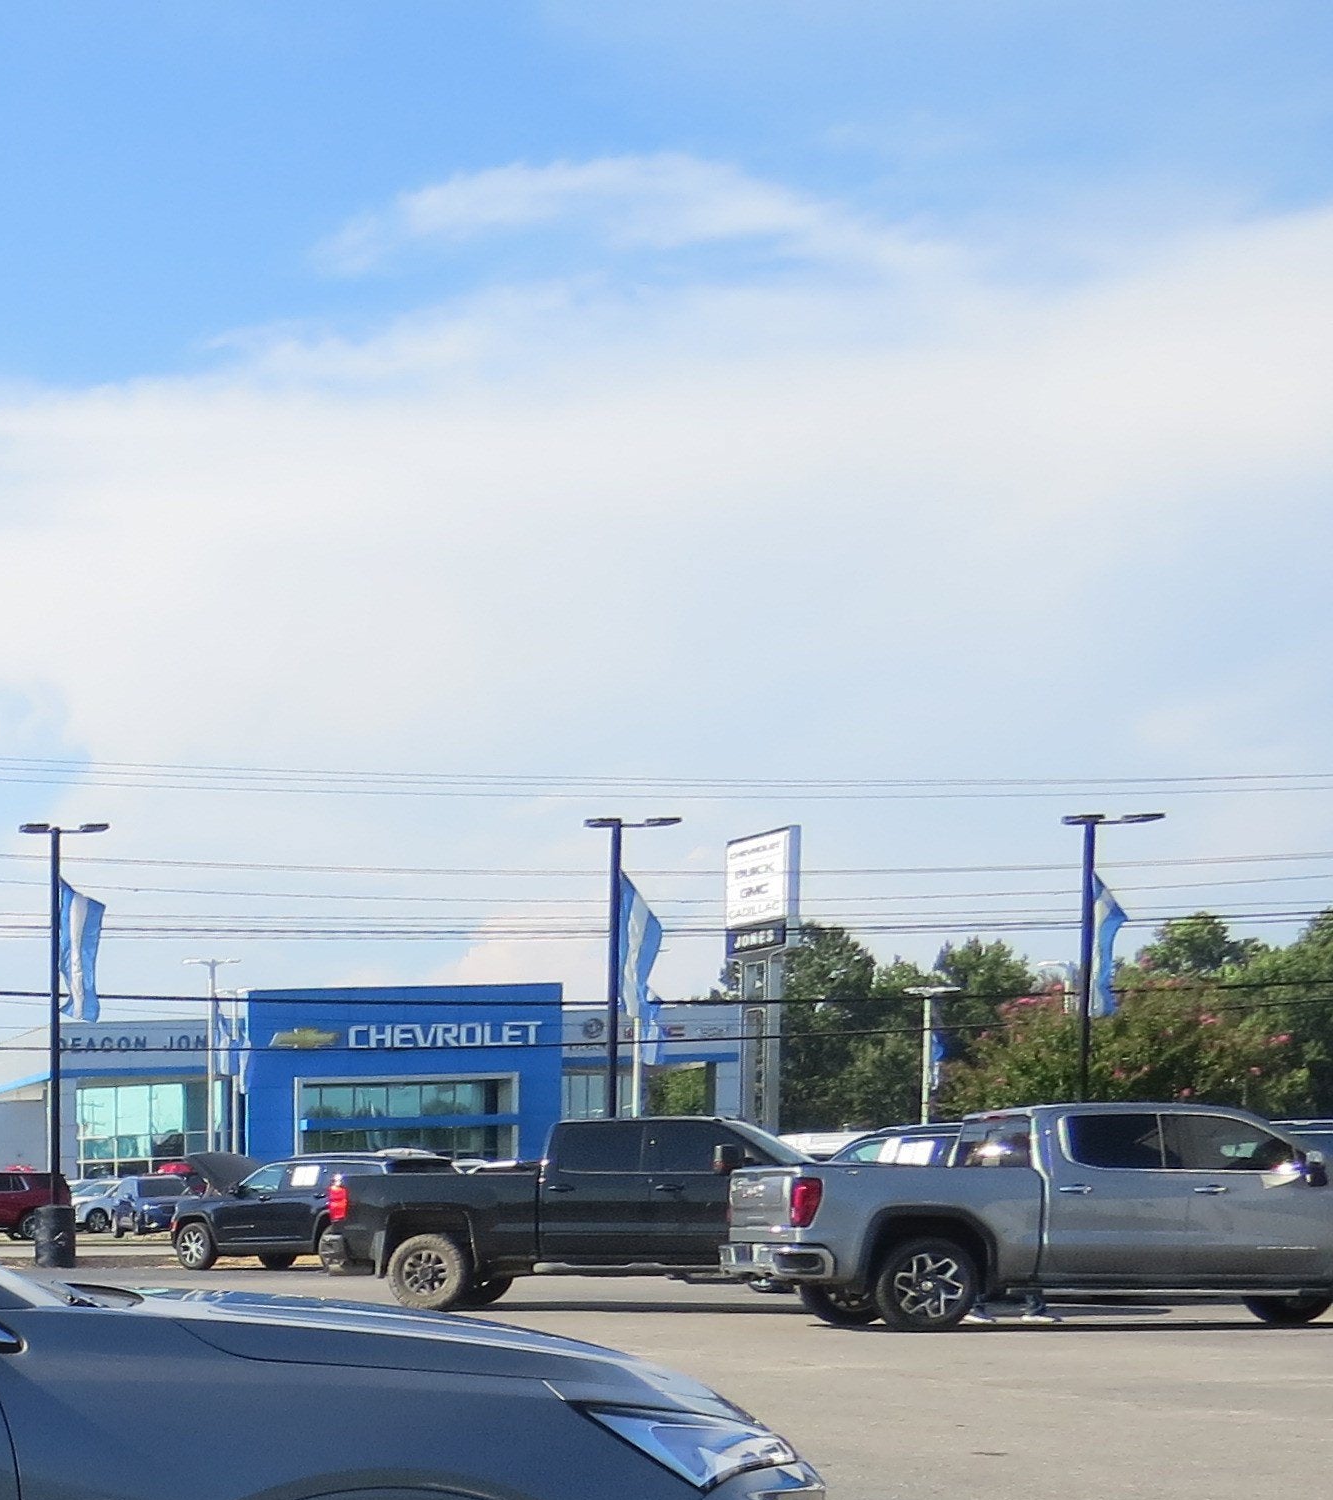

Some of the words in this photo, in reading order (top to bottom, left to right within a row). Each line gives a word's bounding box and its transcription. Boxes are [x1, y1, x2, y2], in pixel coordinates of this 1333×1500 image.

[729, 841, 780, 859] CHEVROLET
[735, 862, 774, 879] BUICK
[739, 882, 769, 899] GMC
[729, 902, 780, 919] CADILLAC
[734, 928, 774, 949] JONES
[164, 1034, 208, 1050] JON
[348, 1021, 542, 1048] CHEVROLET
